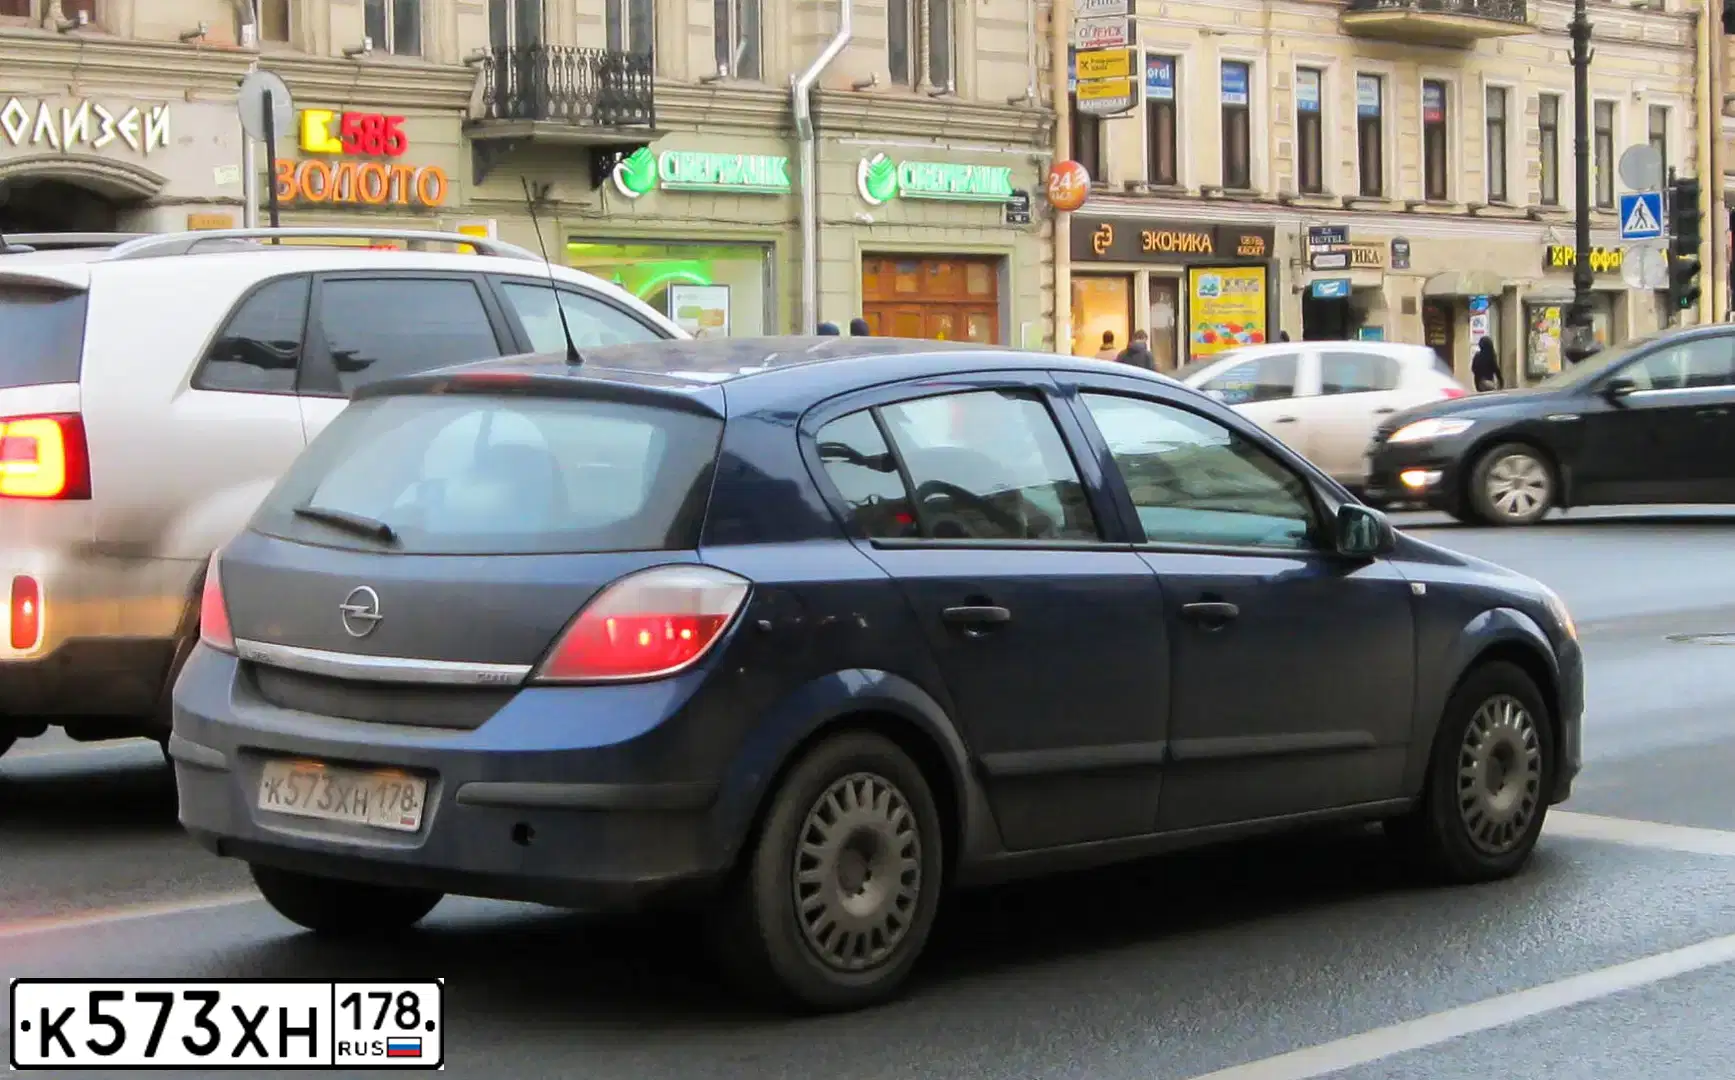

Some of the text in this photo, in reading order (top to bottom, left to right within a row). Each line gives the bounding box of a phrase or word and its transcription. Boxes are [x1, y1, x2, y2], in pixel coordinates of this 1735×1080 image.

[341, 112, 409, 157] 585
[275, 158, 448, 207] ЗОЛОТО
[659, 151, 791, 185] СБЕРБАНК
[898, 160, 1013, 195] СБЕРБАНК
[1049, 171, 1073, 191] 24
[1141, 230, 1214, 253] ЭКОНИКА
[266, 770, 415, 816] К573ХН 178
